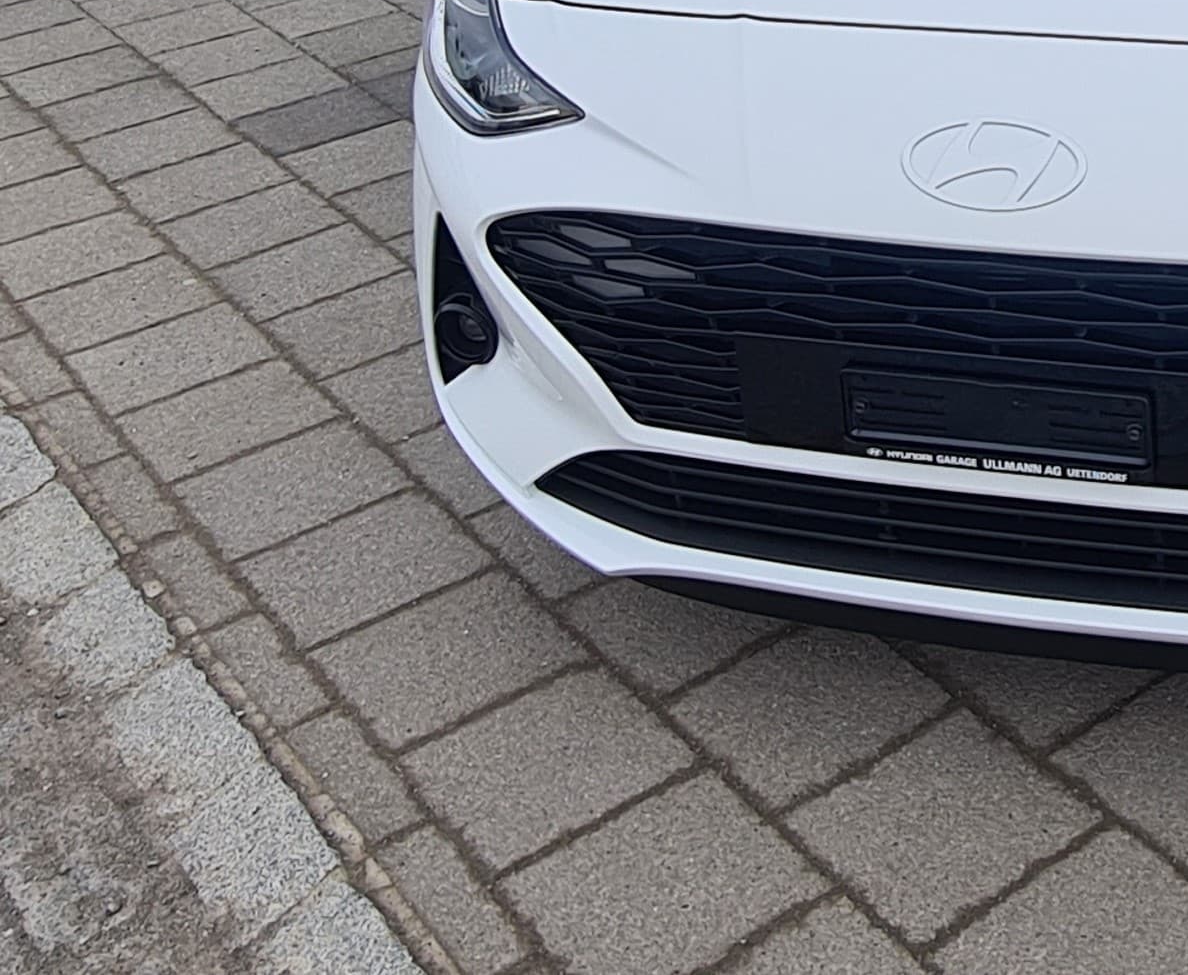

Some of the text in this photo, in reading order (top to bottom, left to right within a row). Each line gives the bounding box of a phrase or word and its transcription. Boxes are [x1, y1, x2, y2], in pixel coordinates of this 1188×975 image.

[936, 454, 978, 467] GARAGE
[982, 458, 1042, 474] ULLMANN
[1066, 468, 1128, 482] UETENDORF
